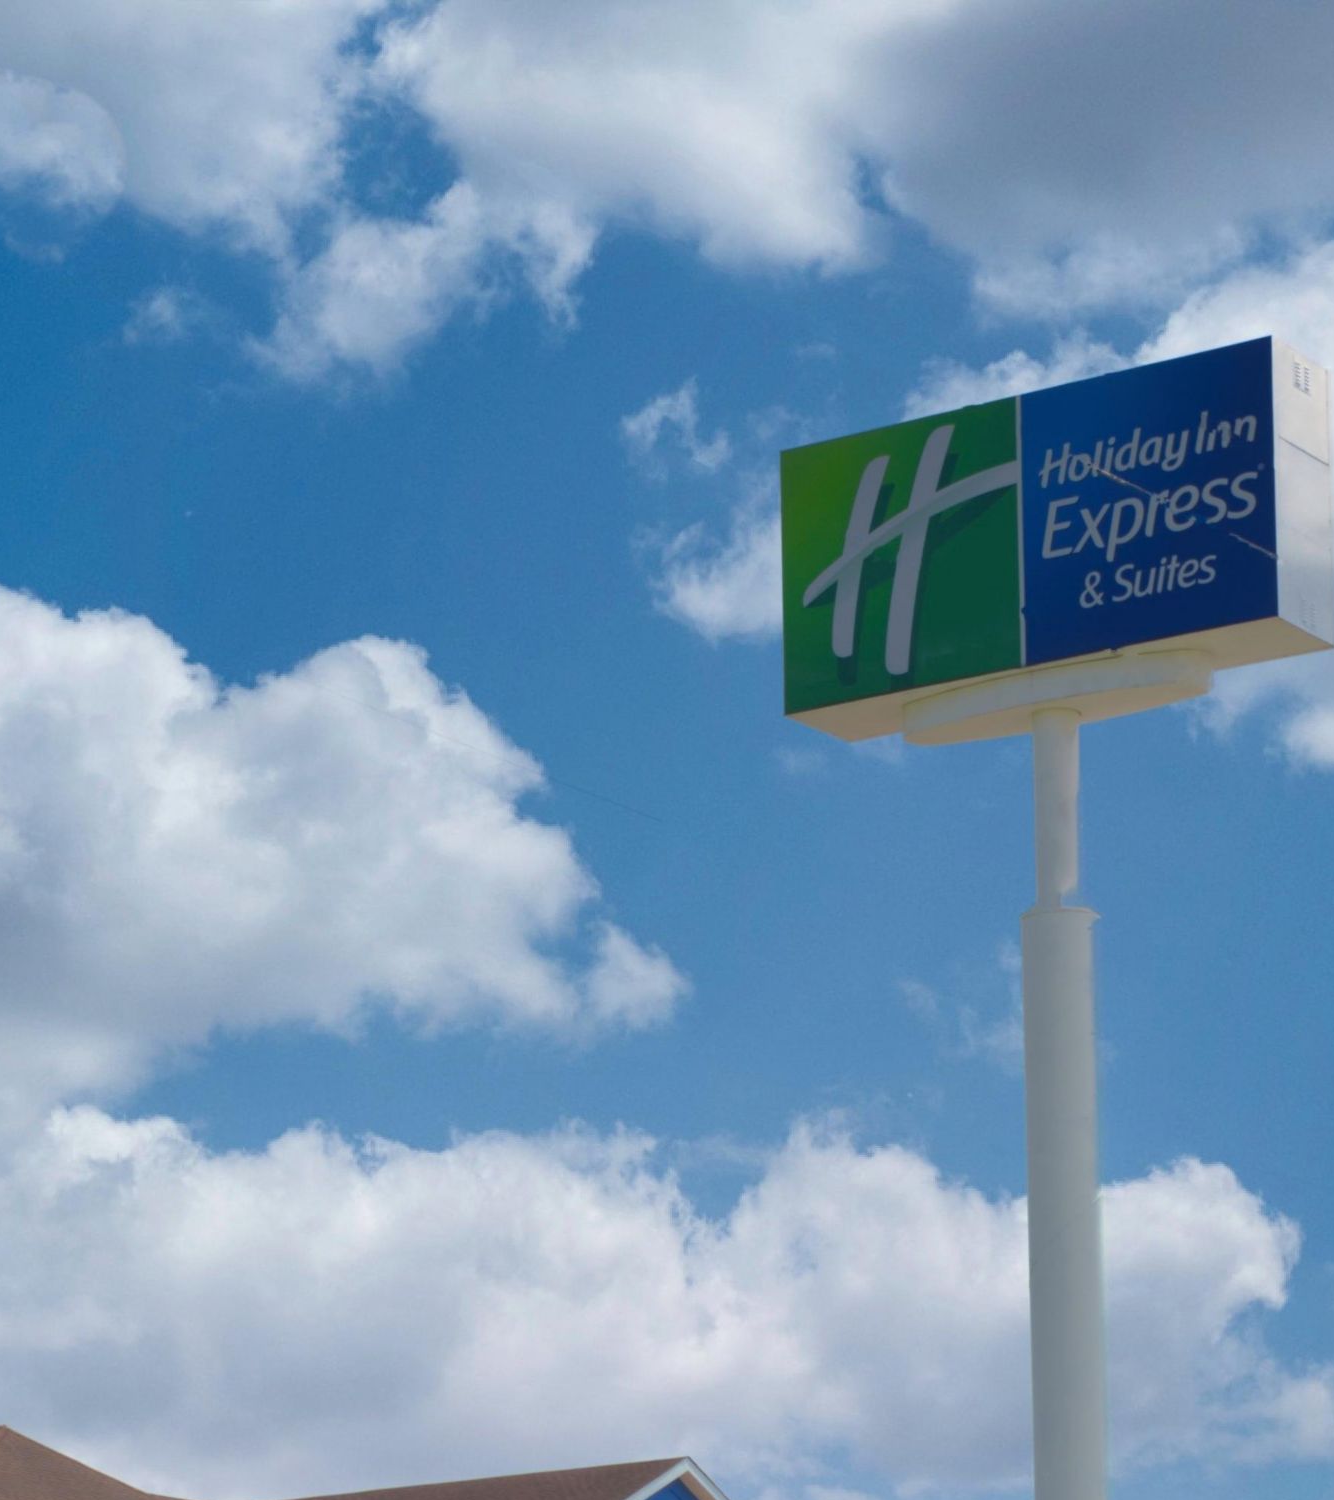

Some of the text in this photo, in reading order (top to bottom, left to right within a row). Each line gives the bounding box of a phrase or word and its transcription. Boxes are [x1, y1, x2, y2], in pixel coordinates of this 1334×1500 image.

[1038, 411, 1257, 488] Holiday Inn
[1042, 472, 1258, 562] Express
[1079, 555, 1216, 608] & Suites
